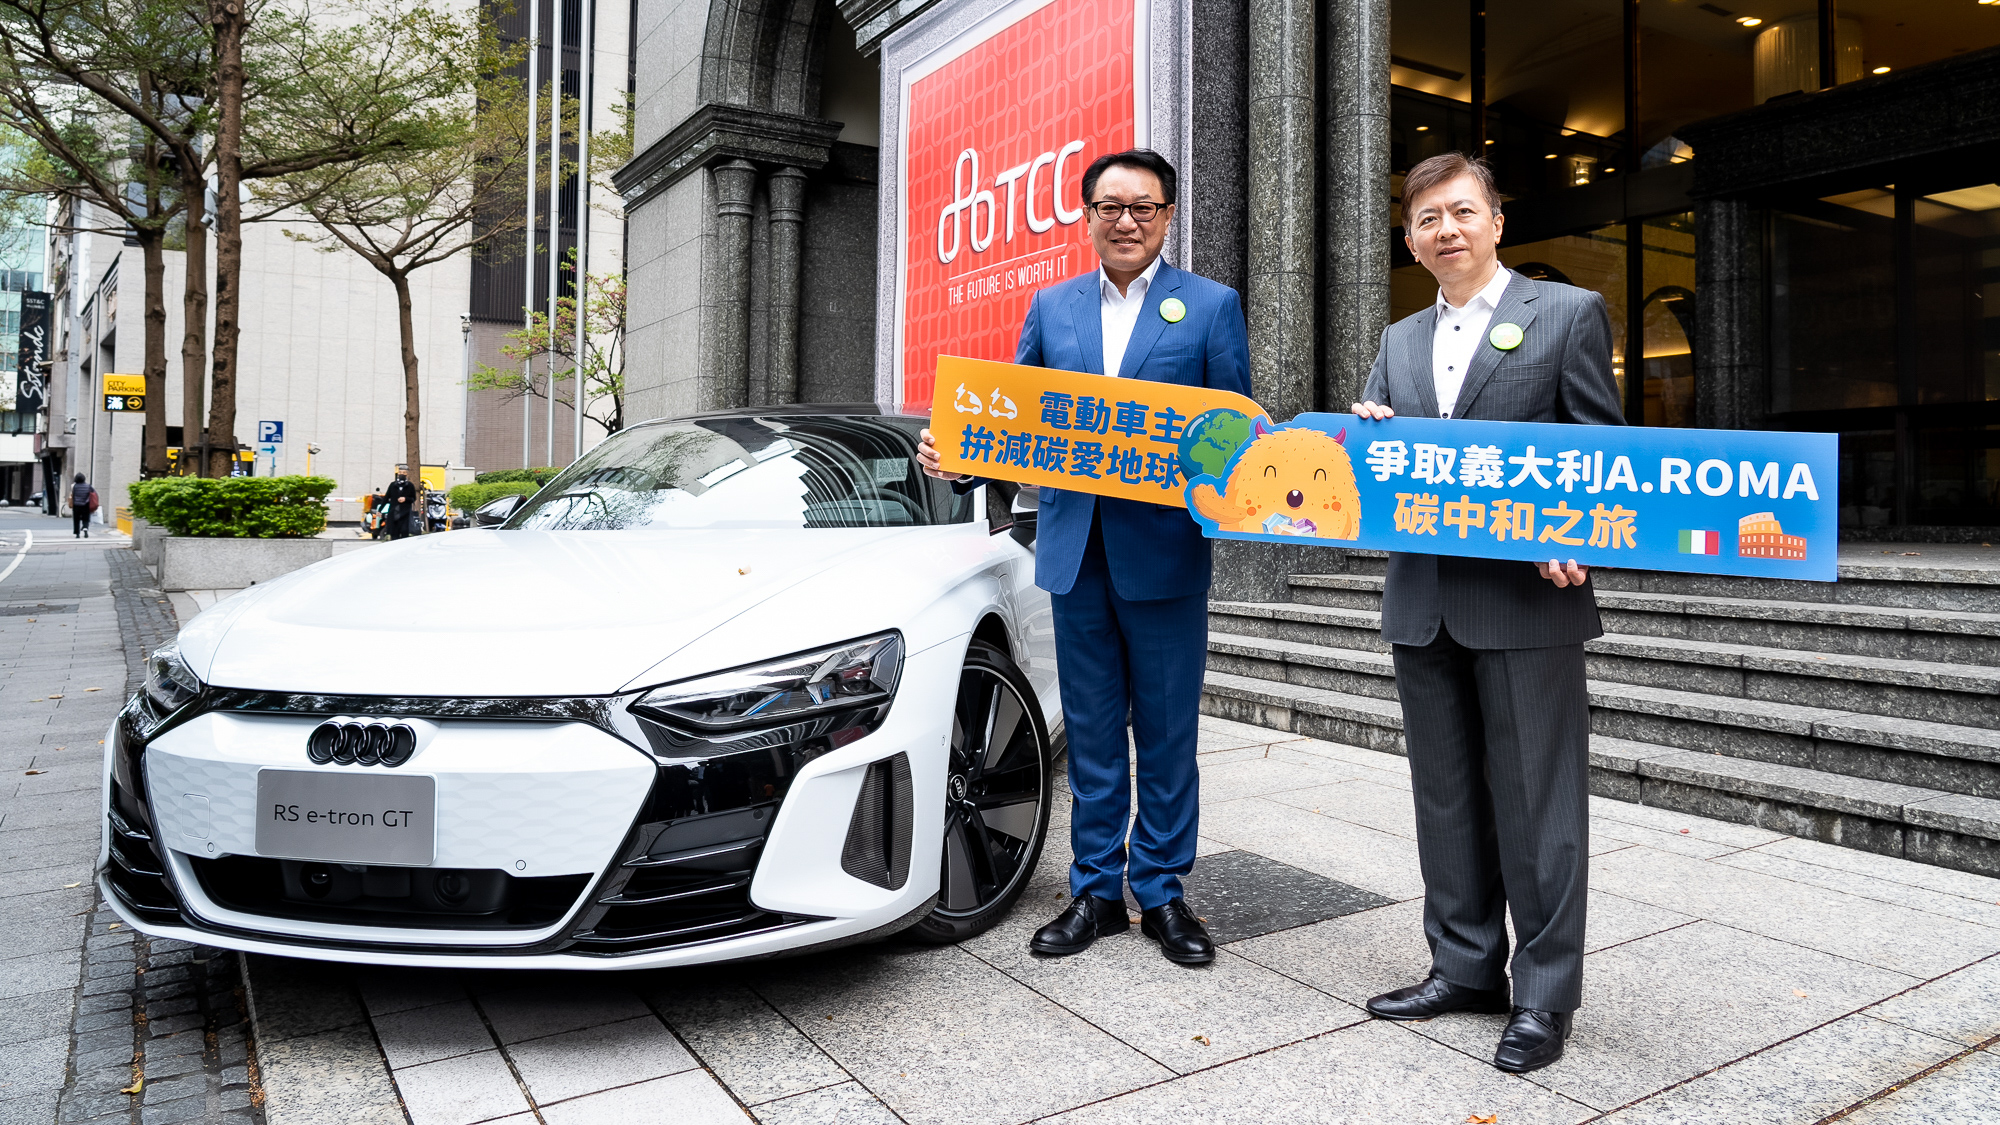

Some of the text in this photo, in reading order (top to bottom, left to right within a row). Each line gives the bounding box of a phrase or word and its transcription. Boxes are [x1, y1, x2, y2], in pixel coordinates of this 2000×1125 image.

[948, 255, 1068, 306] THE FUTURE IS WORTH IT
[260, 421, 278, 441] P
[1039, 390, 1187, 445] 電動車主
[1393, 492, 1638, 549] 碳中和之旅
[274, 804, 414, 828] RS e-tron GT
